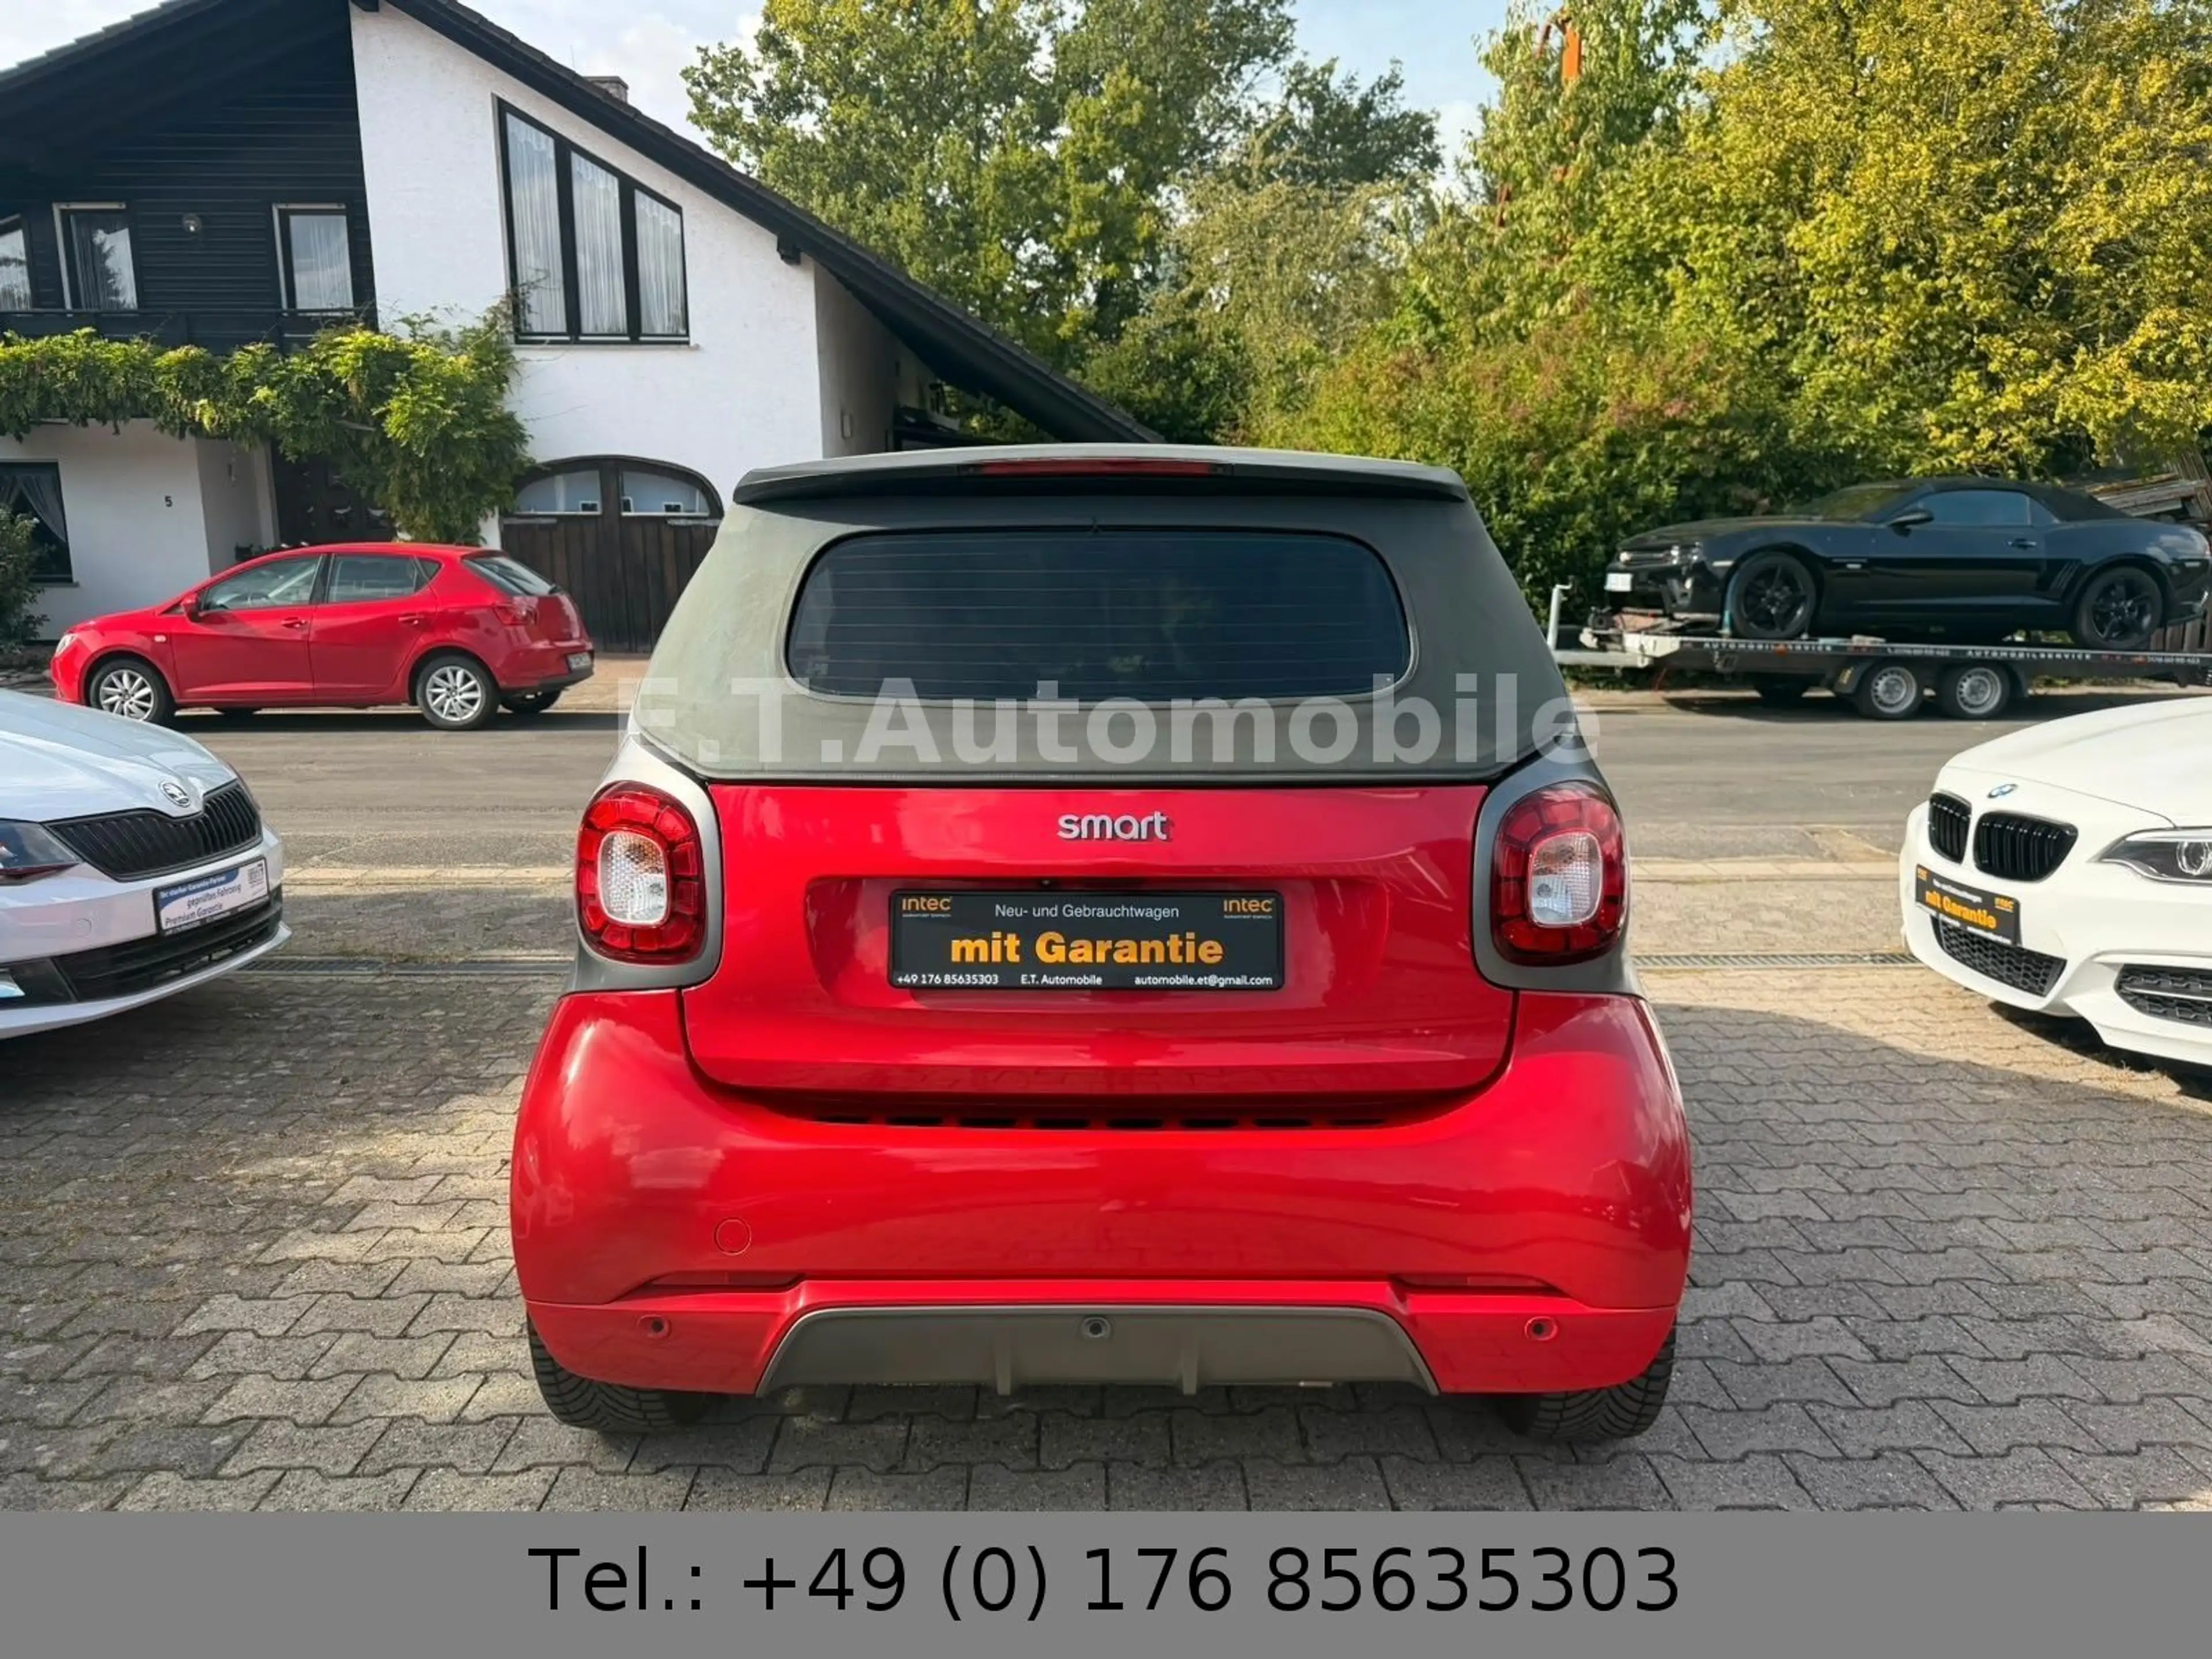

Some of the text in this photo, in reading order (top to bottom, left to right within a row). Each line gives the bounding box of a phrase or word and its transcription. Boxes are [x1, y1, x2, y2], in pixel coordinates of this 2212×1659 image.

[165, 495, 172, 507] 5
[1058, 811, 1168, 840] smart
[902, 897, 951, 911] intec
[1224, 899, 1273, 913] intec
[1925, 890, 1941, 909] mit
[1942, 895, 1997, 929] Garantie
[995, 904, 1179, 921] Neu- und Gebrauchtwagen
[951, 931, 1224, 964] mit Garantie
[897, 974, 999, 984] +49 176 85635303
[1021, 974, 1103, 985] E.T. Automobile
[1135, 975, 1273, 987] automobile.et@gmail.com
